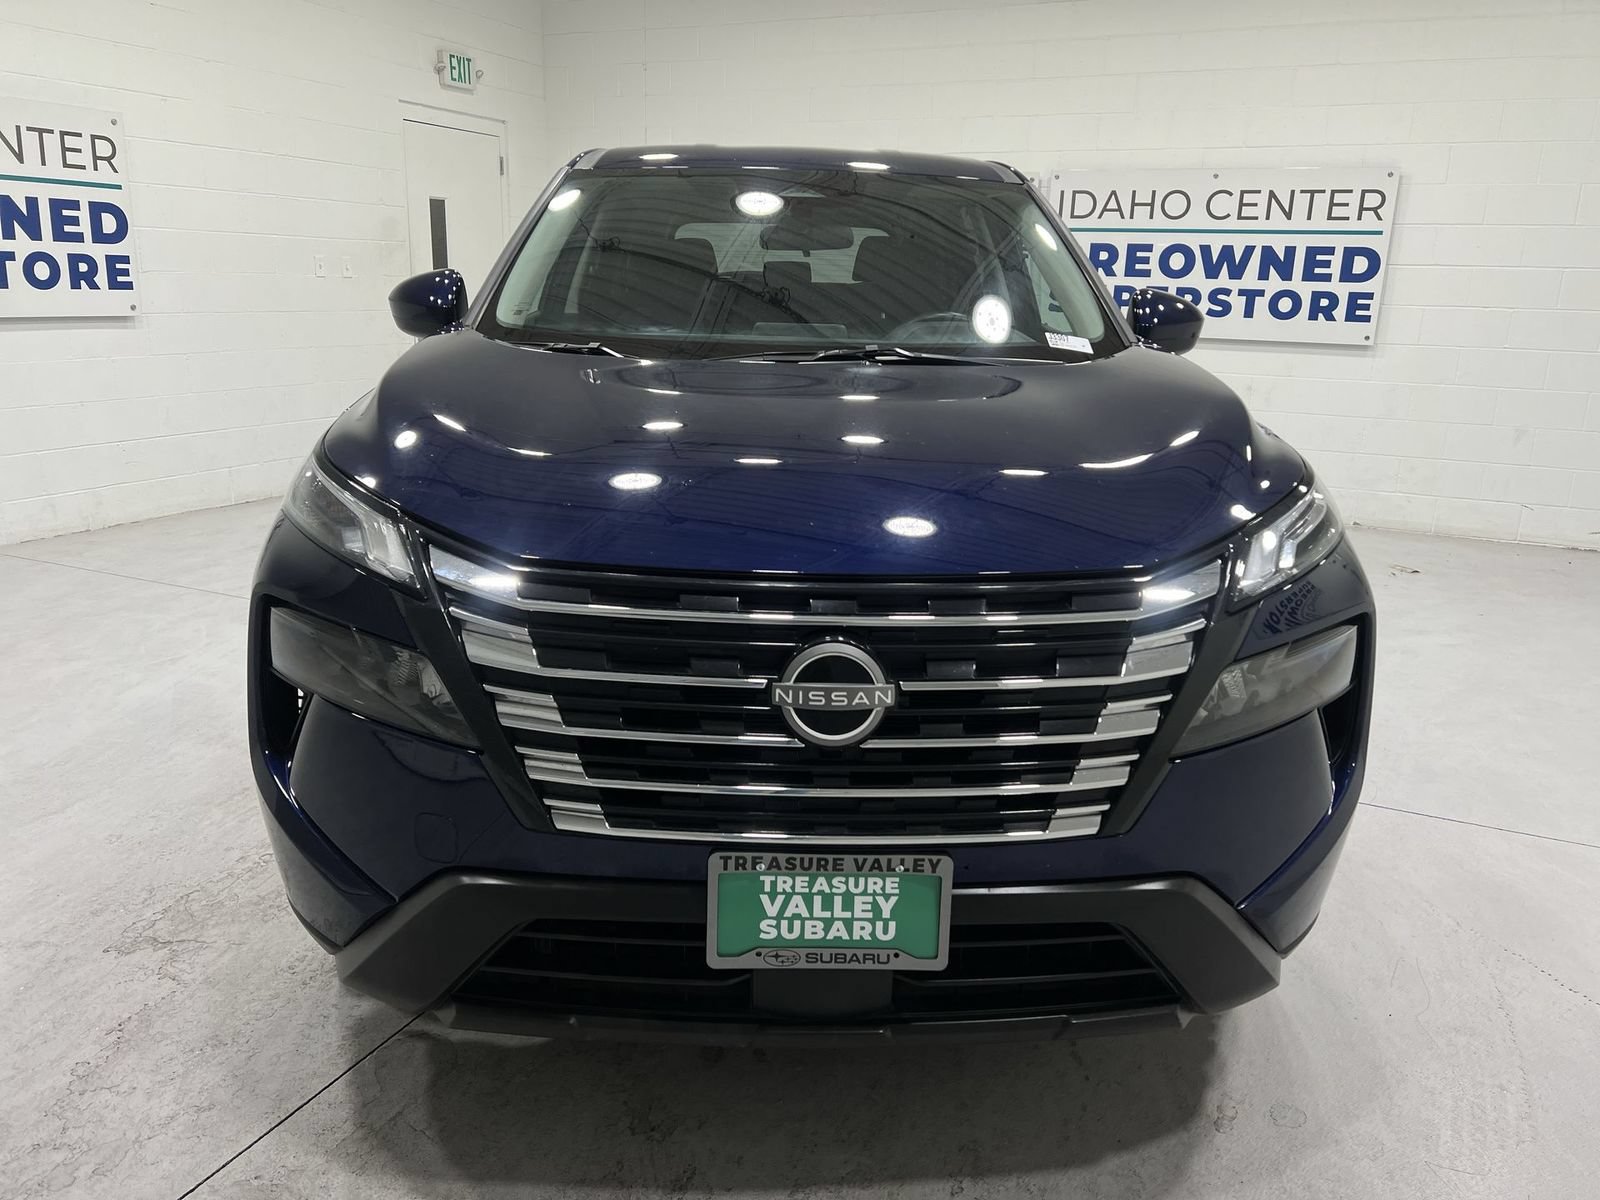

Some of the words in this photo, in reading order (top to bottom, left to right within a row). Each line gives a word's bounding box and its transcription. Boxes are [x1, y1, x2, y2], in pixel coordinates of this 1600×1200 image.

[449, 54, 471, 84] EXIT
[1058, 189, 1191, 220] IDAHO
[1206, 190, 1386, 221] CENTER
[0, 194, 129, 245] NED
[1089, 243, 1381, 283] REOWNED
[775, 688, 892, 705] NISSAN
[719, 856, 845, 872] TREASURE
[853, 858, 942, 873] VALLEY
[759, 875, 900, 894] TREASURE
[759, 894, 899, 918] VALLEY
[759, 919, 897, 941] SUBARU
[805, 952, 890, 965] SUBARU
